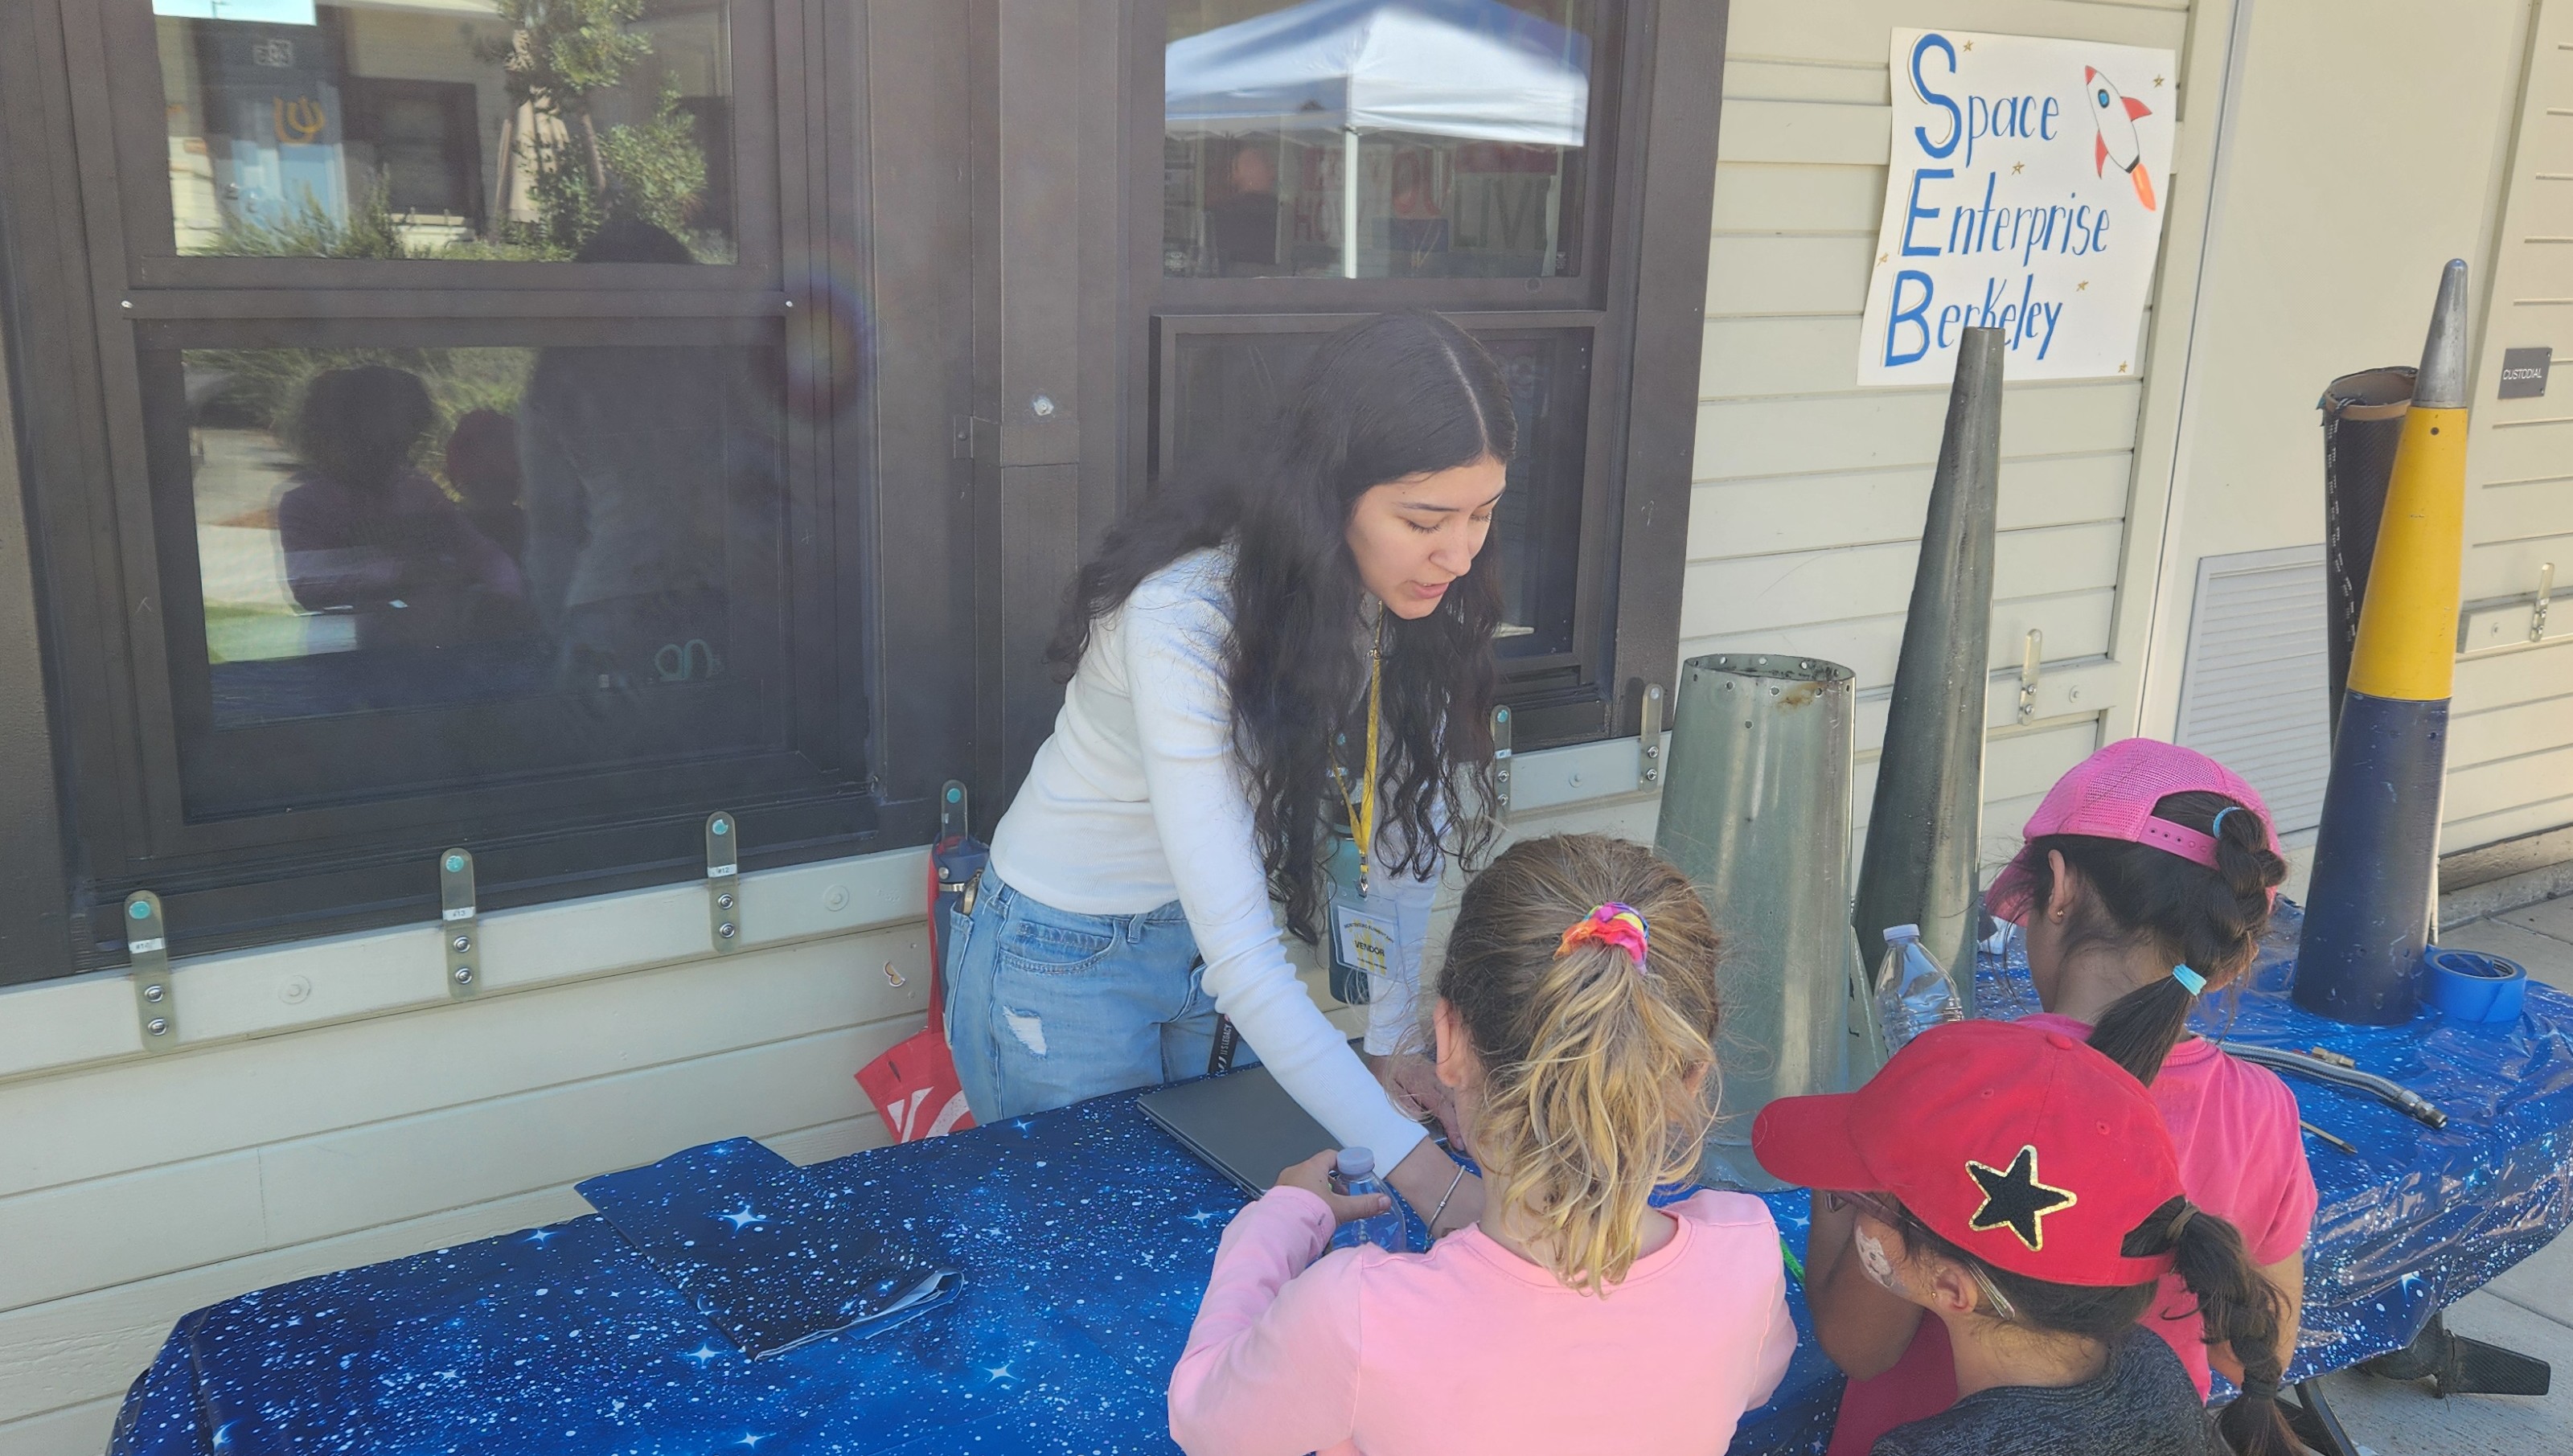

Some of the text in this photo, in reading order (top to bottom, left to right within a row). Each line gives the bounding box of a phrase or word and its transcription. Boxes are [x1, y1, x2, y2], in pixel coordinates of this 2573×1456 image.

[1910, 33, 2059, 168] Space
[1901, 168, 2110, 267] Enterprise
[1884, 269, 2063, 367] Berkeley
[2502, 367, 2542, 380] CUSTODIAL
[1354, 939, 1385, 958] VENDOR
[1221, 1023, 1232, 1045] LEGACY
